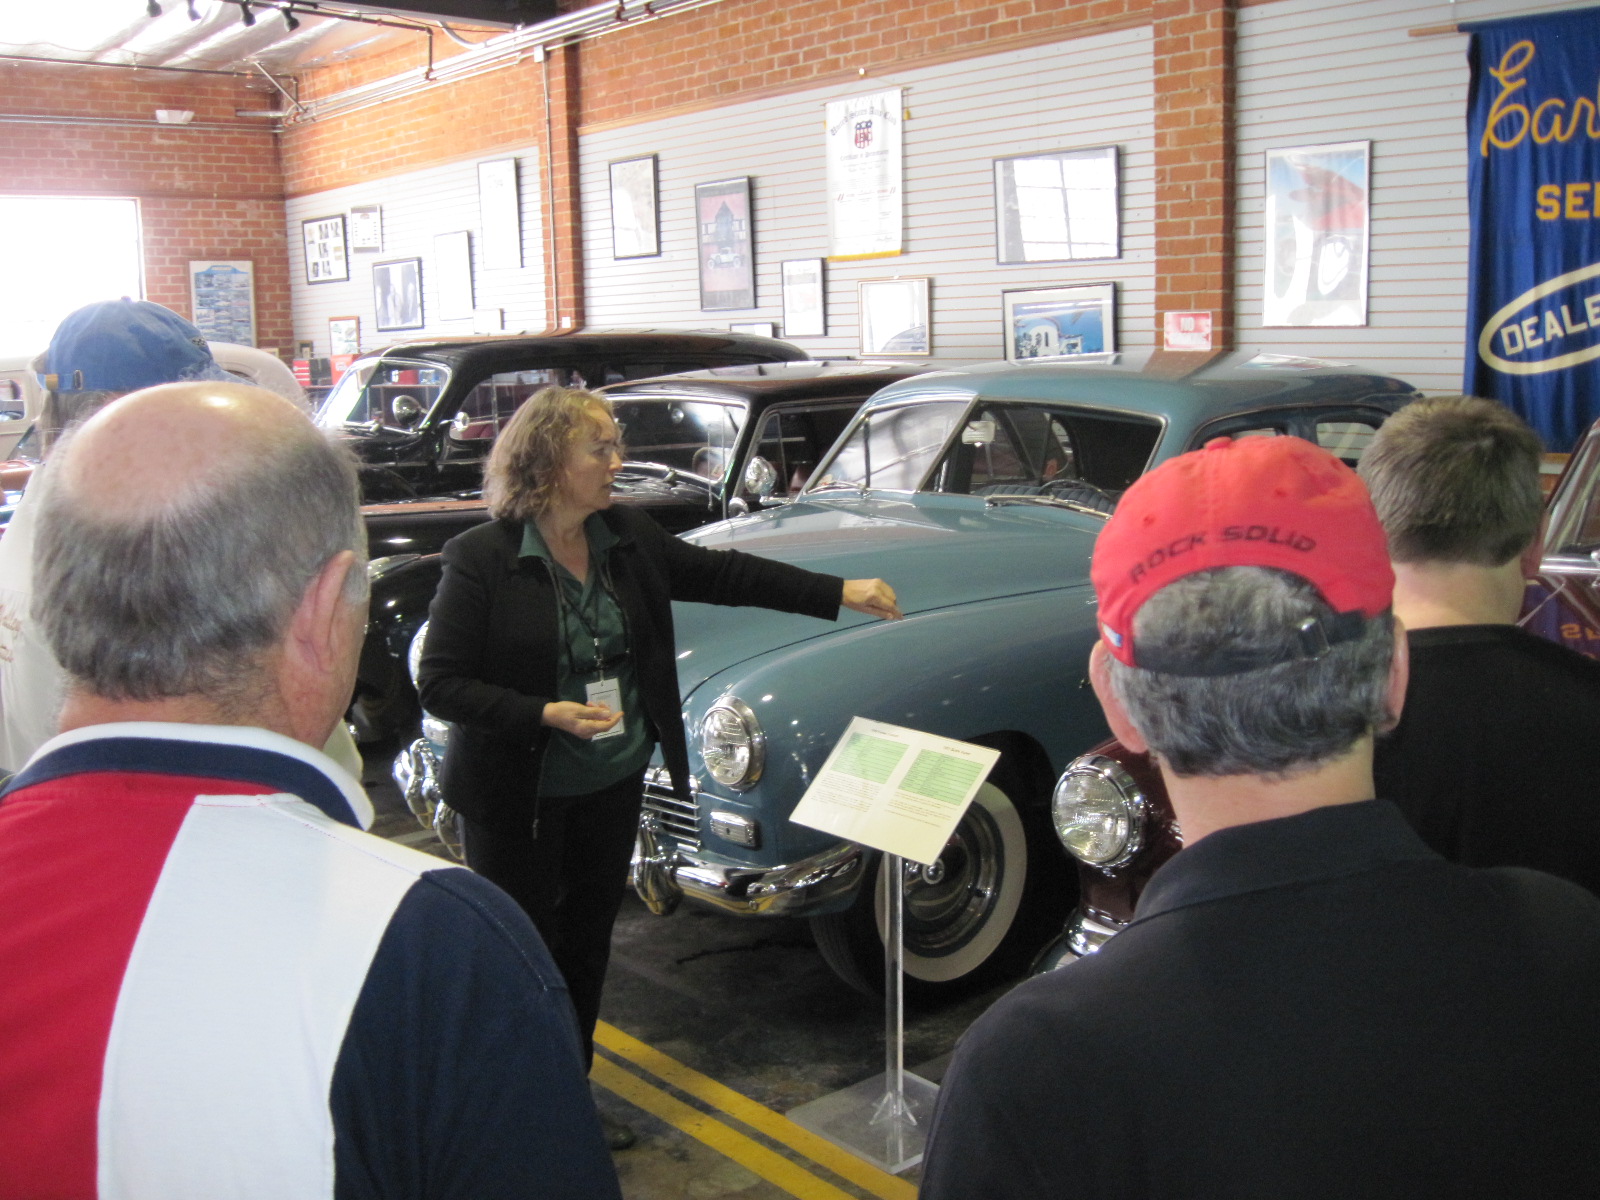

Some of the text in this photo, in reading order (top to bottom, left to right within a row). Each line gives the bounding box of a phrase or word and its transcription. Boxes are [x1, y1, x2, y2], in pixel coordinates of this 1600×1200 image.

[1480, 40, 1600, 158] Ear
[1129, 525, 1317, 584] ROCK SOLID
